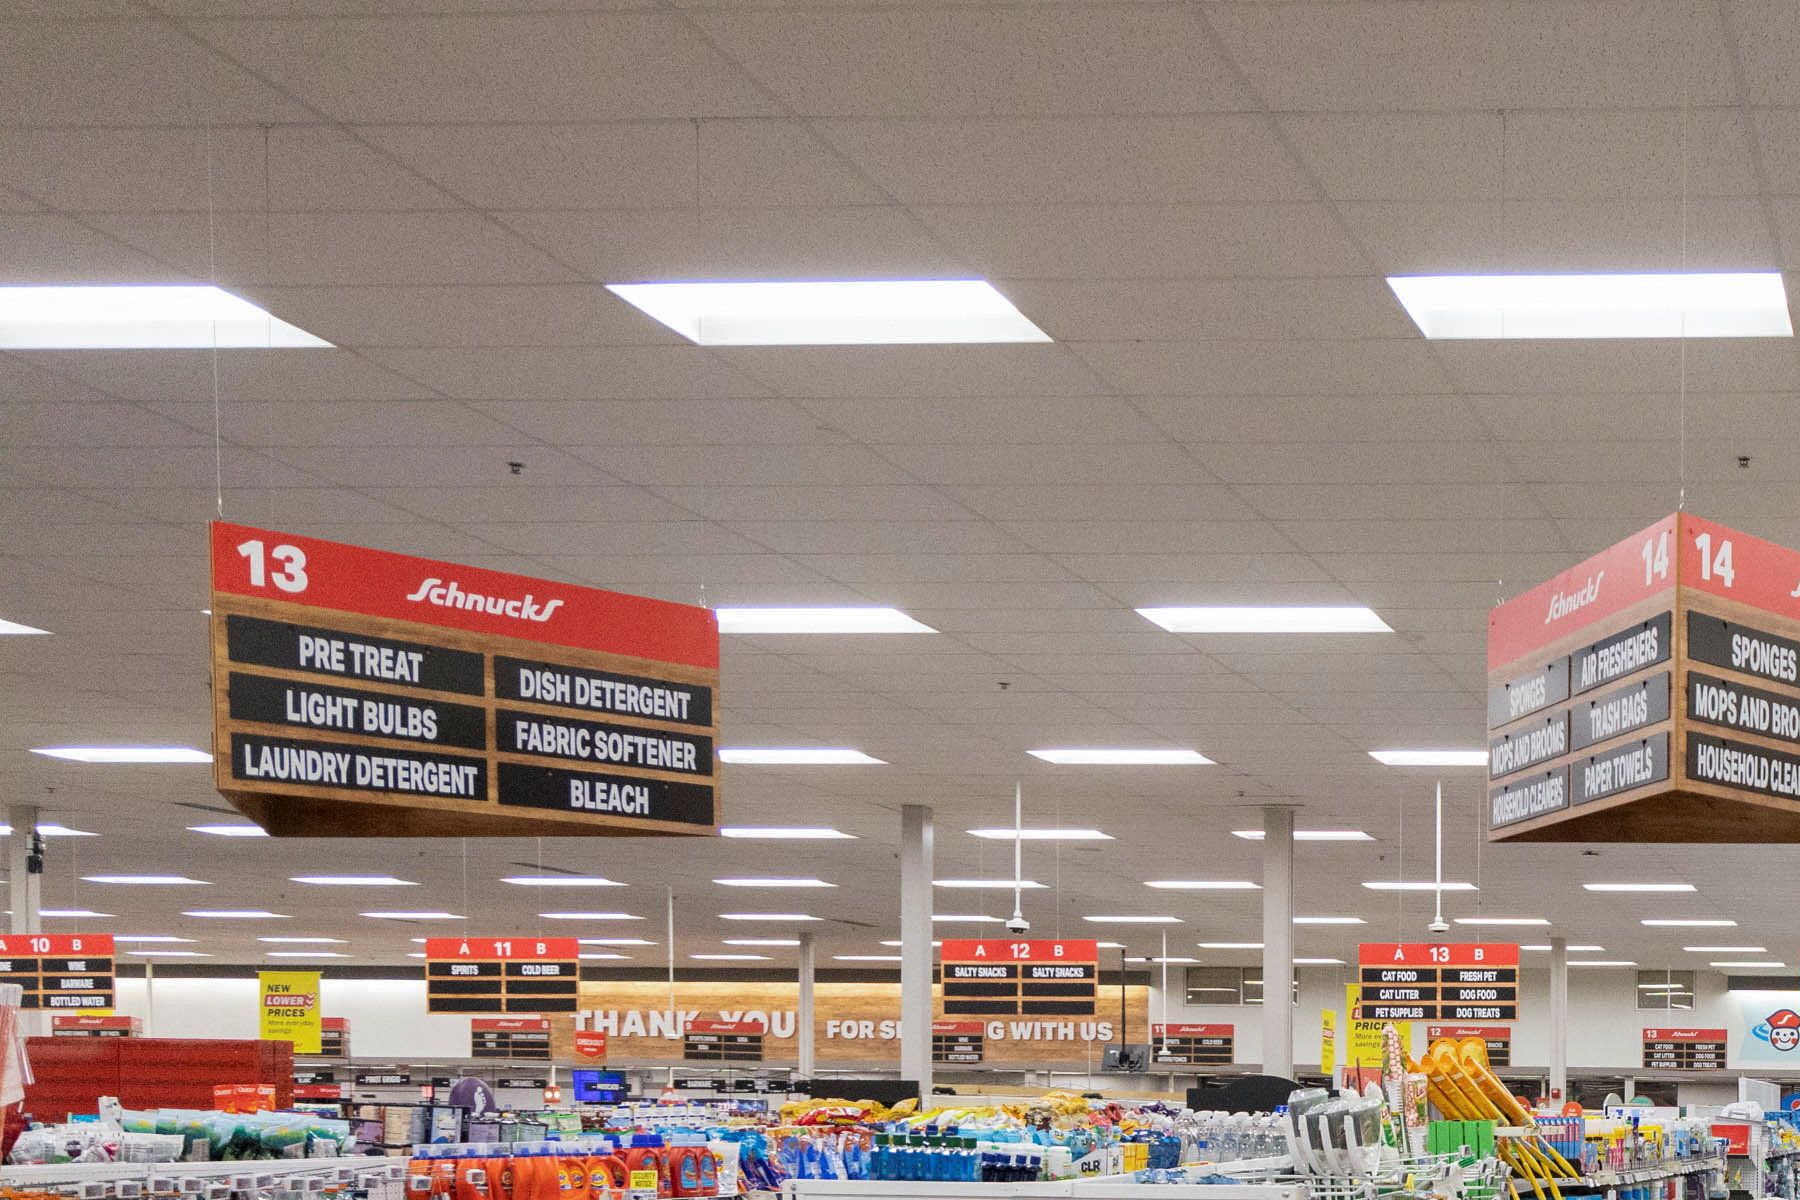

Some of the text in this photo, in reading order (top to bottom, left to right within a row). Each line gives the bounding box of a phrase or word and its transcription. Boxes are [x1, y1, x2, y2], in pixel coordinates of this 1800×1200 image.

[238, 539, 308, 592] 13
[1642, 531, 1669, 586] 14
[1695, 532, 1735, 588] 14
[407, 577, 563, 622] Schnucks
[1545, 571, 1603, 624] Schnucks
[299, 635, 423, 683] PRE TREAT
[1581, 628, 1657, 685] AIR FRESHENERS
[1732, 633, 1797, 682] SPONGES
[519, 668, 691, 720] DISH DETERGENT
[1509, 675, 1545, 716] SPONGES
[286, 689, 437, 740] LIGHT BULBS
[1590, 689, 1647, 740] TRASH BAGS
[1695, 683, 1737, 725] MOPS
[1740, 695, 1770, 732] AND
[516, 721, 697, 771] FABRIC SOFTENER
[1492, 720, 1565, 774] MOPS AND BROOMS
[245, 743, 477, 796] LAUNDRY DETERGENT
[1584, 747, 1652, 797] PAPER TOWELS
[1698, 743, 1768, 790] HOUSEHOLD
[570, 778, 649, 814] BLEACH
[1492, 777, 1563, 825] HOUSEHOLD CLEANERS
[30, 938, 82, 952] 10 B
[459, 942, 546, 956] A 11 B
[976, 943, 1063, 958] A 12 B
[1394, 946, 1483, 963] A 13 B
[451, 965, 478, 975] SPIRITS
[522, 965, 560, 975] COLD BEER
[955, 966, 1007, 978] SALTY SNACKS
[1032, 966, 1084, 978] SALTY SNACKS
[1382, 972, 1417, 981] CAT FOOD
[1460, 972, 1497, 981] FRESH PET
[267, 984, 290, 993] NEW
[1380, 990, 1419, 1000] CAT LITTER
[1460, 990, 1496, 1000] DOG FOOD
[51, 997, 104, 1007] BOTTLED WATER
[267, 996, 304, 1005] LOWER
[268, 1009, 305, 1017] PRICES
[1376, 1008, 1423, 1018] PET SUPPLIES
[1456, 1008, 1500, 1018] DOG TREATS
[569, 1010, 700, 1038] THANK
[827, 1020, 875, 1039] FOR
[1010, 1021, 1081, 1040] WITH
[1085, 1022, 1113, 1041] US
[1431, 1028, 1441, 1036] 12
[1646, 1030, 1657, 1038] 13
[1080, 1160, 1102, 1174] CLR
